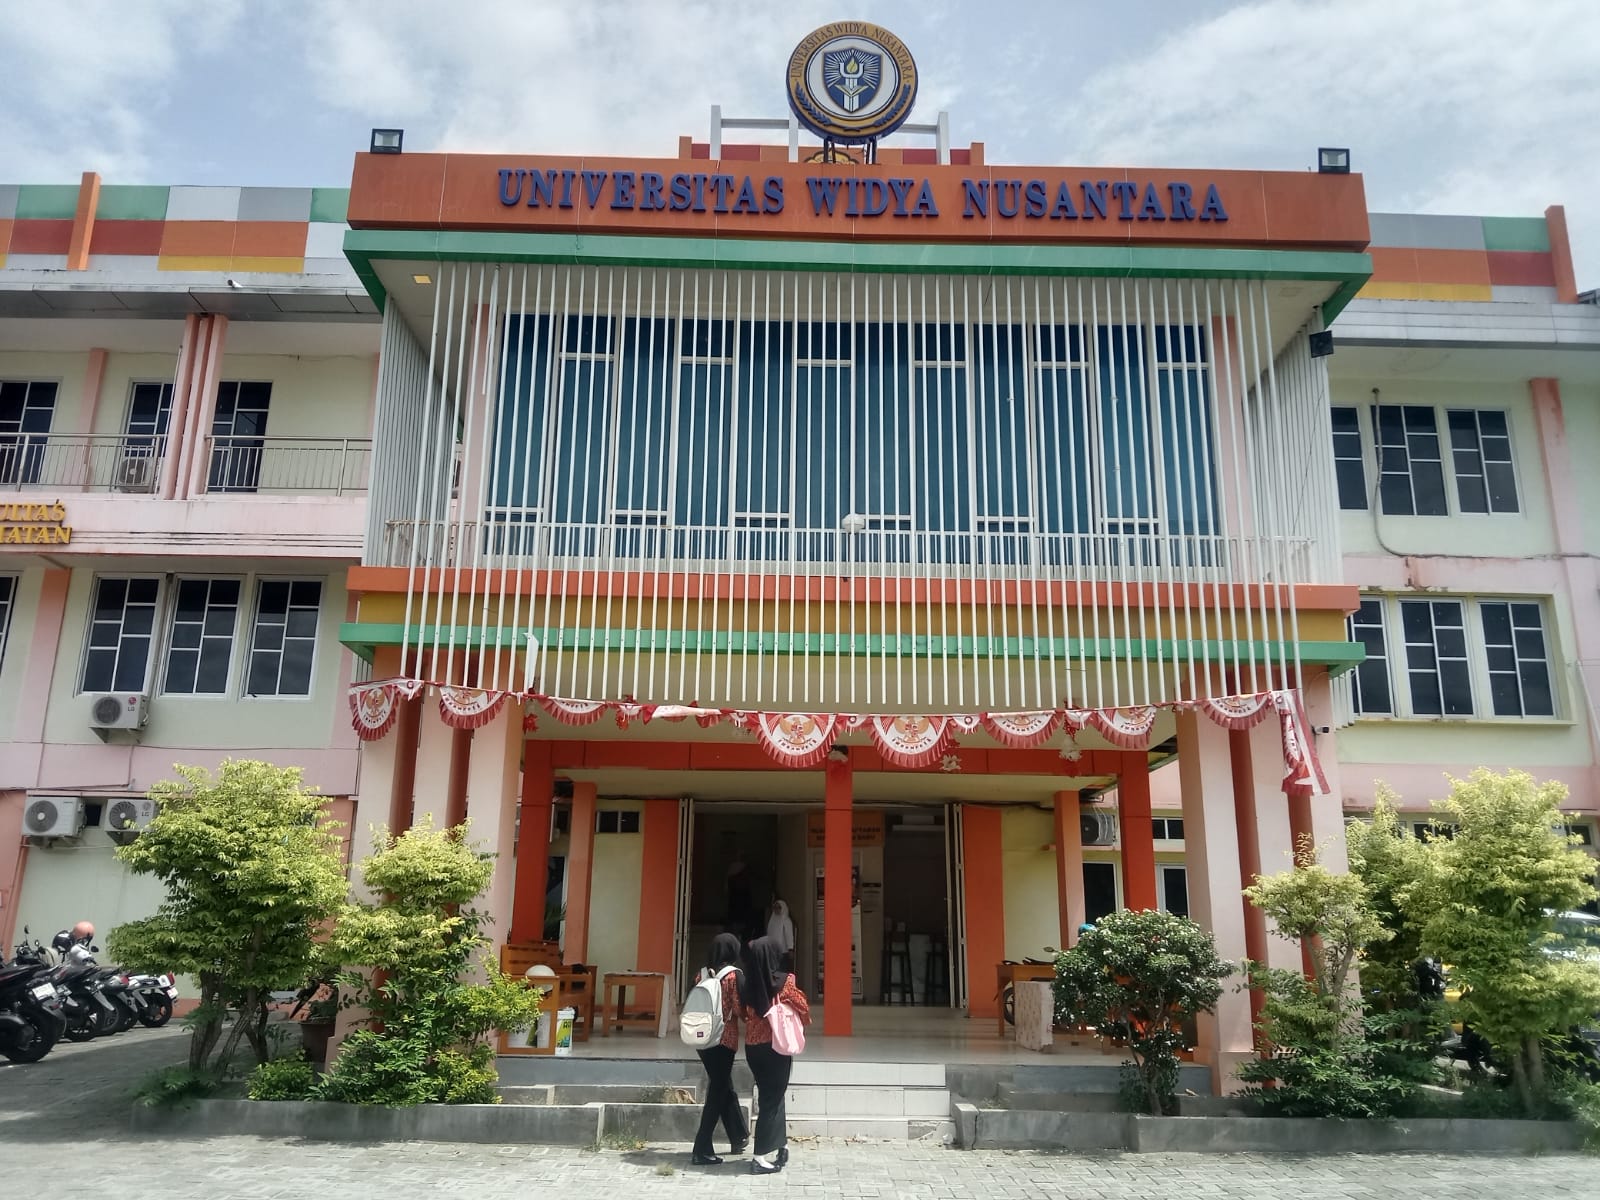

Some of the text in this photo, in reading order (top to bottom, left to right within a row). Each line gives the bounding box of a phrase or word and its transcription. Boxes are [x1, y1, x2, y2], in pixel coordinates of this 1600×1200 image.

[833, 23, 868, 35] WIDYA
[498, 168, 1229, 223] UNIVERSITAS WIDYA NUSANTARA
